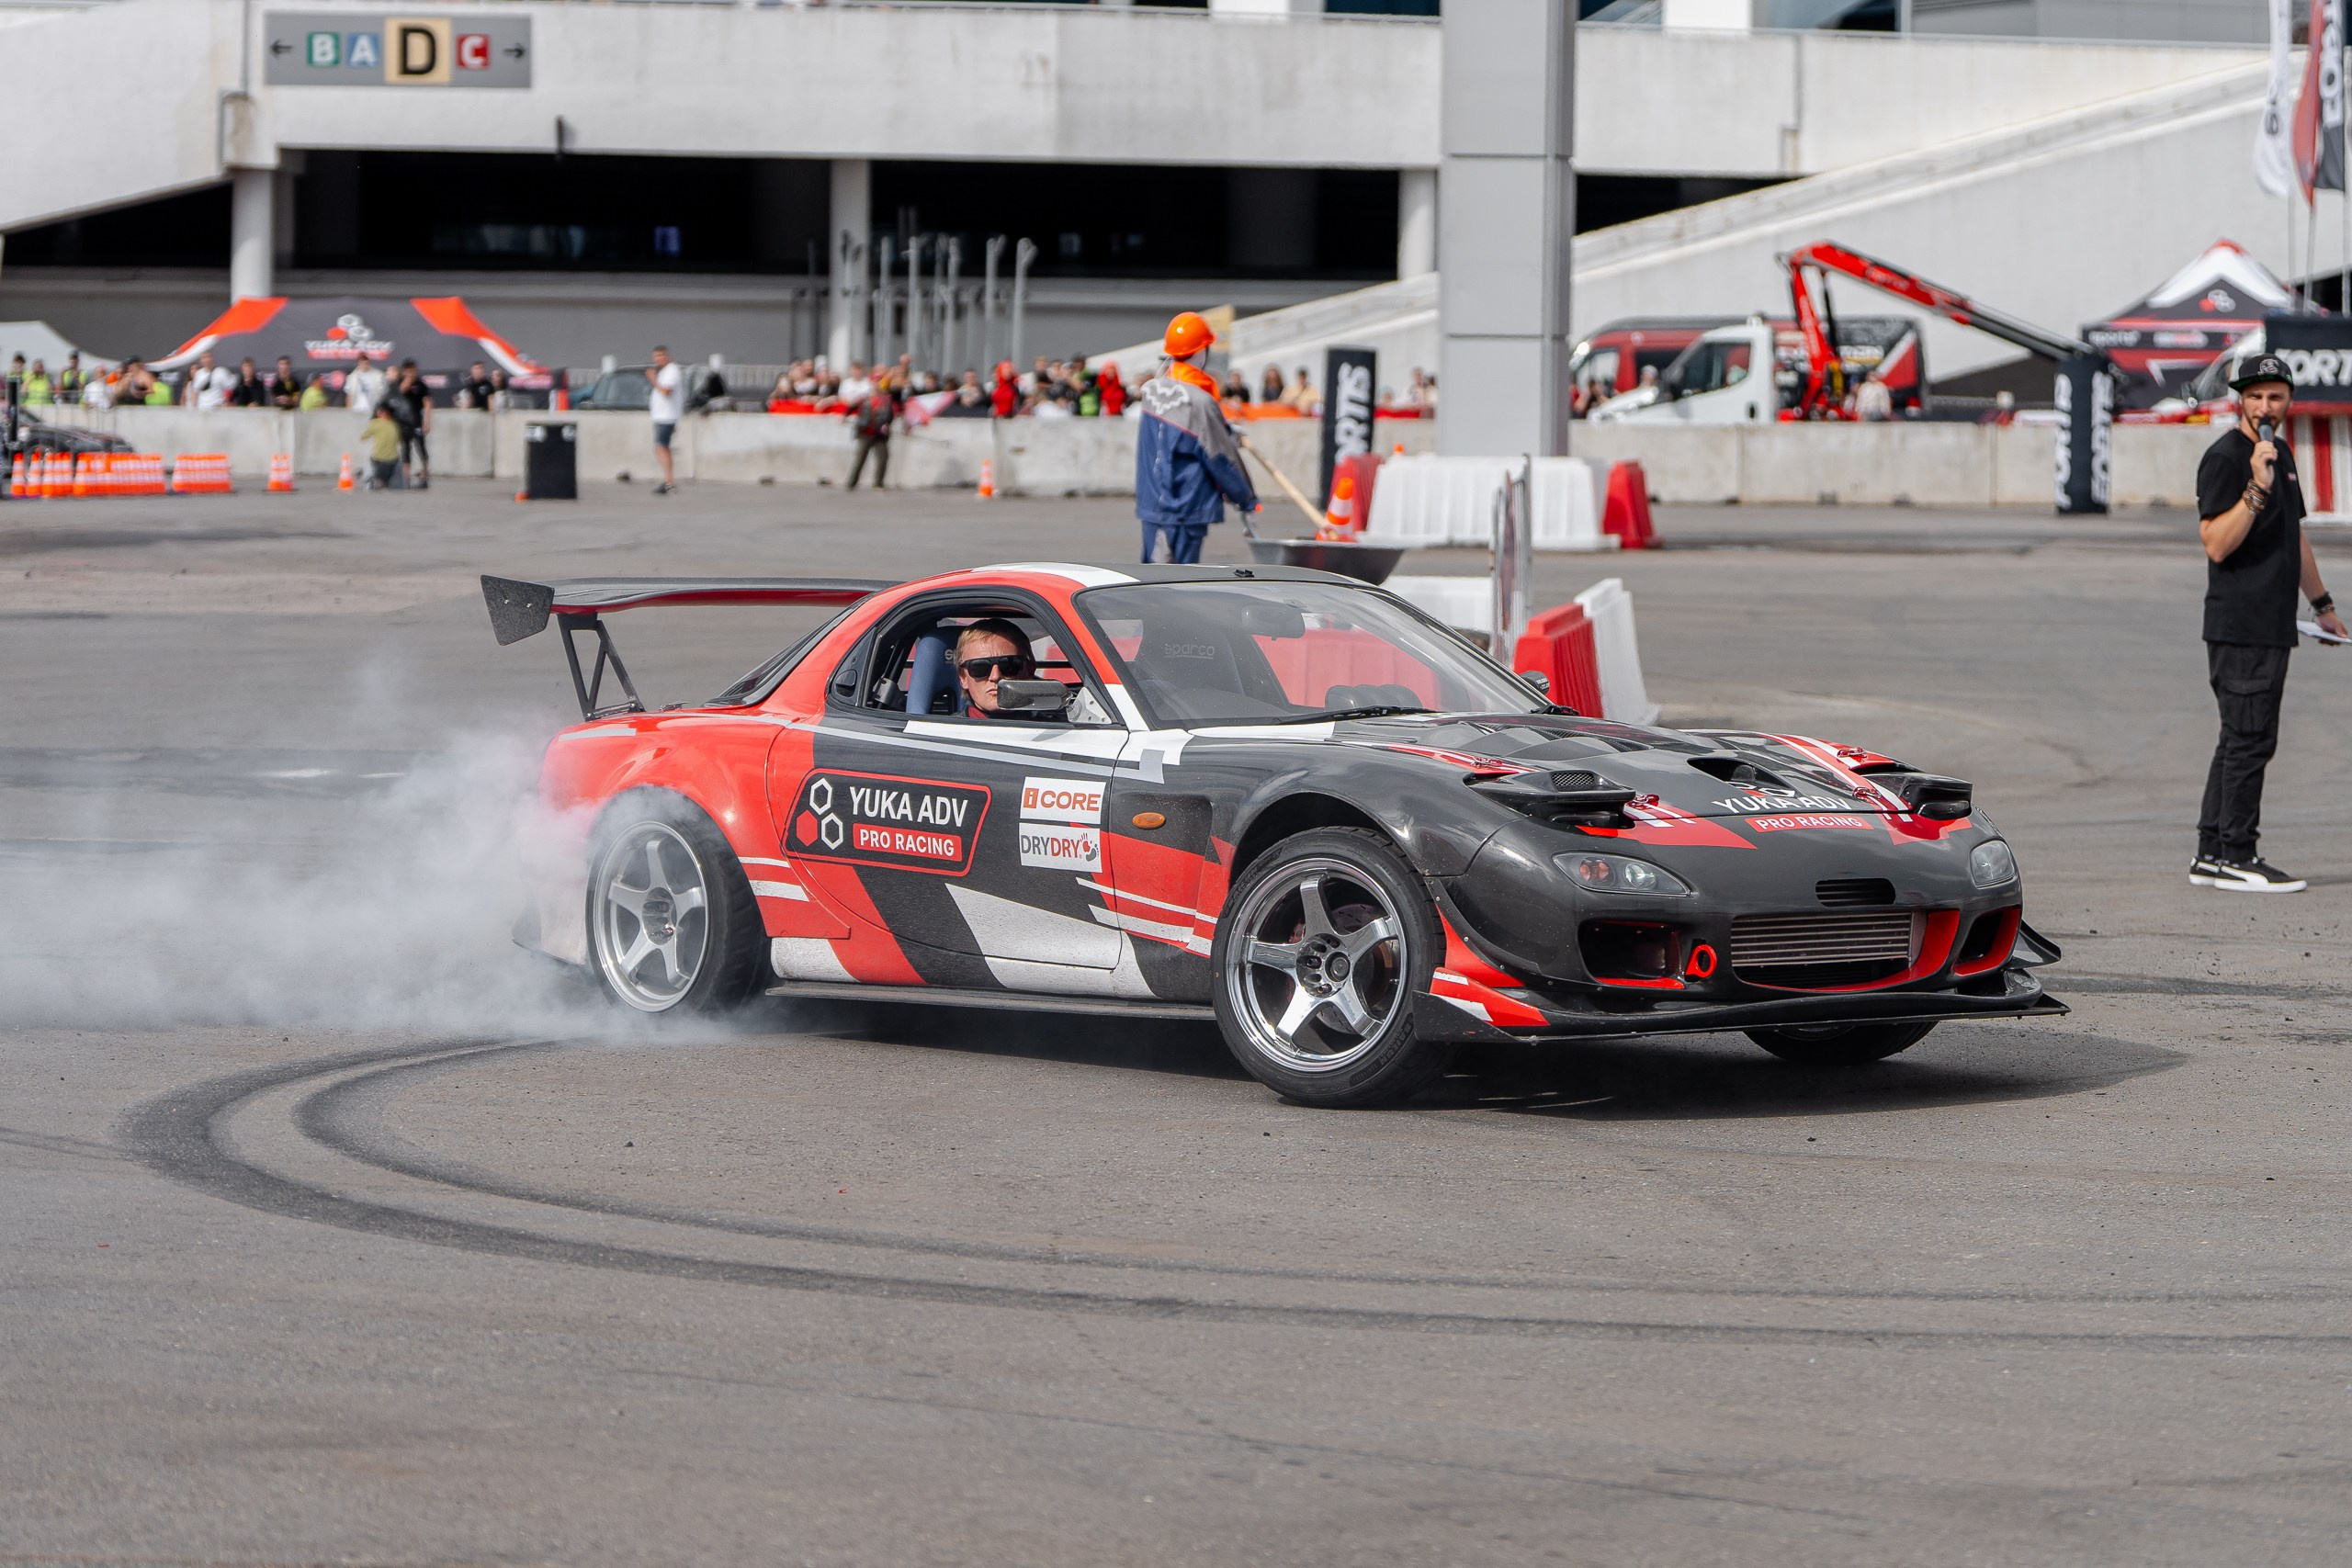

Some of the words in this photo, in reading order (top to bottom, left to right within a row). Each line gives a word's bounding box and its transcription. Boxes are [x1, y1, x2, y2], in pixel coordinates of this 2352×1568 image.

[311, 33, 336, 63] B
[349, 34, 377, 65] A
[399, 27, 436, 75] D
[461, 35, 485, 66] C
[849, 785, 913, 821] YUKA
[917, 795, 968, 827] ADV
[1711, 795, 1801, 814] YUKA
[1800, 795, 1852, 810] ADV
[1755, 817, 1795, 829] PRO
[1794, 816, 1863, 828] RACING
[859, 829, 891, 849] PRO
[895, 832, 955, 857] RACING
[1021, 834, 1080, 859] DRYDRY
